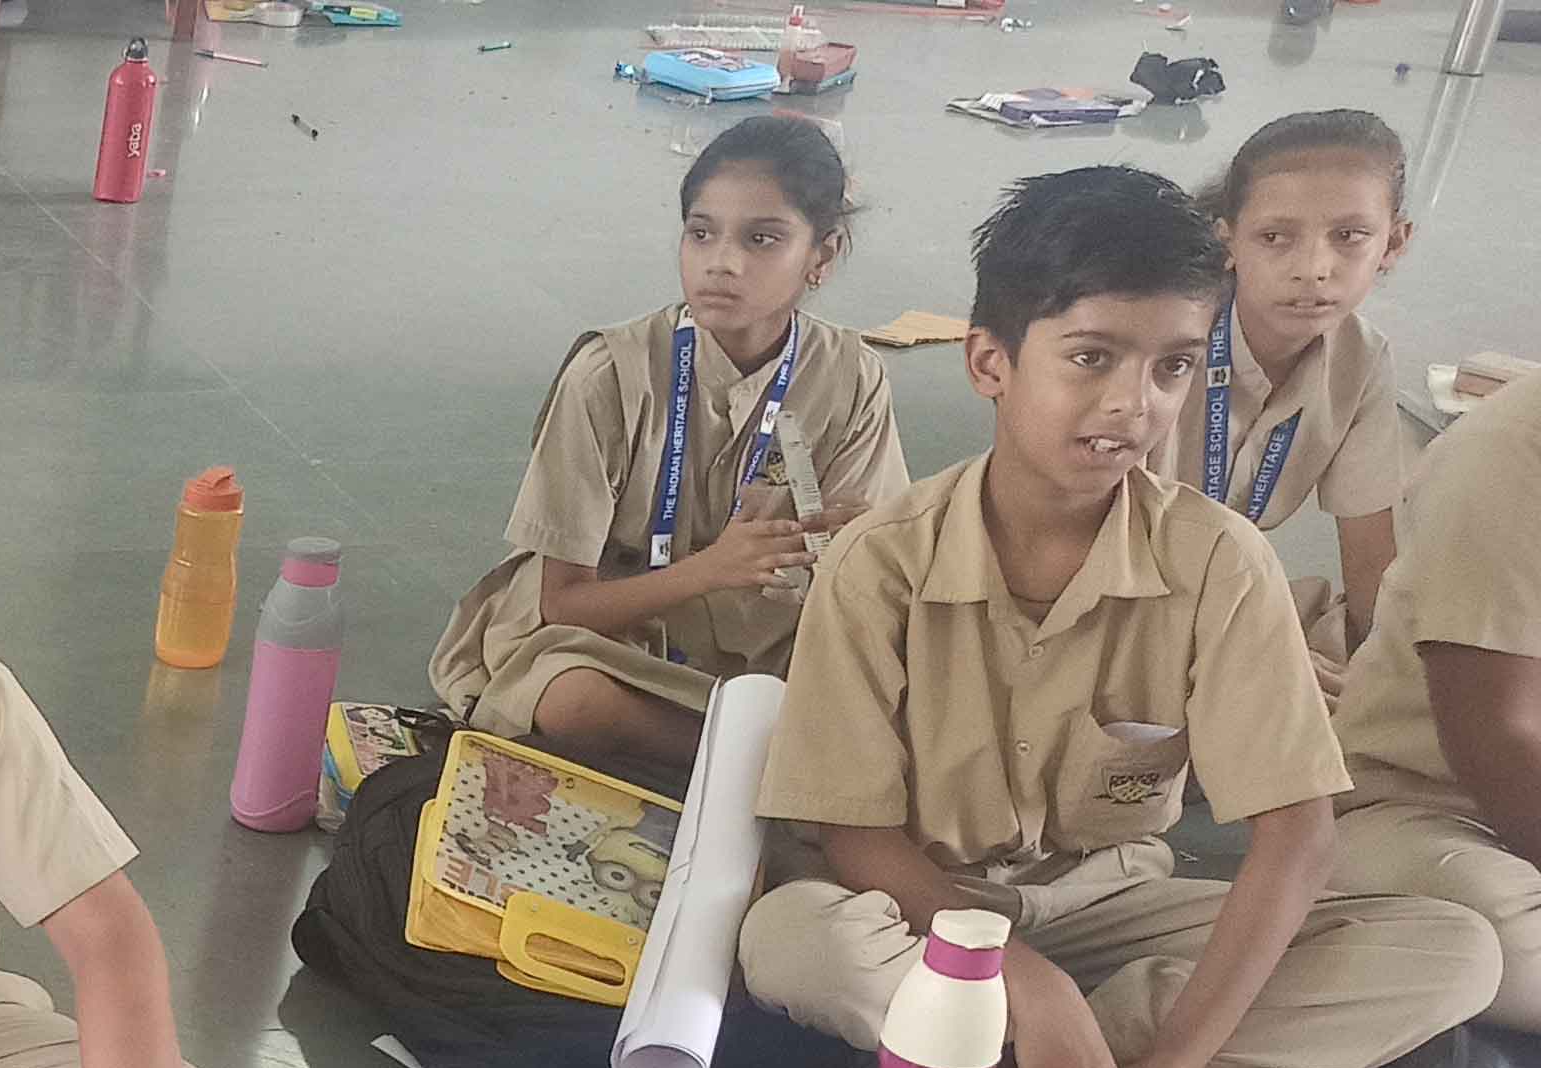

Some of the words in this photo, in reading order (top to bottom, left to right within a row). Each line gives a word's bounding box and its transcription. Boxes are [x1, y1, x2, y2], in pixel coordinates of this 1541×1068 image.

[679, 342, 694, 393] SCHOOL
[1213, 330, 1225, 361] THE
[671, 395, 688, 453] HERITAGE
[1209, 393, 1224, 452] SCHOOL
[666, 453, 681, 497] INDIAN
[1250, 431, 1286, 503] HERITAGE
[663, 498, 675, 521] THE
